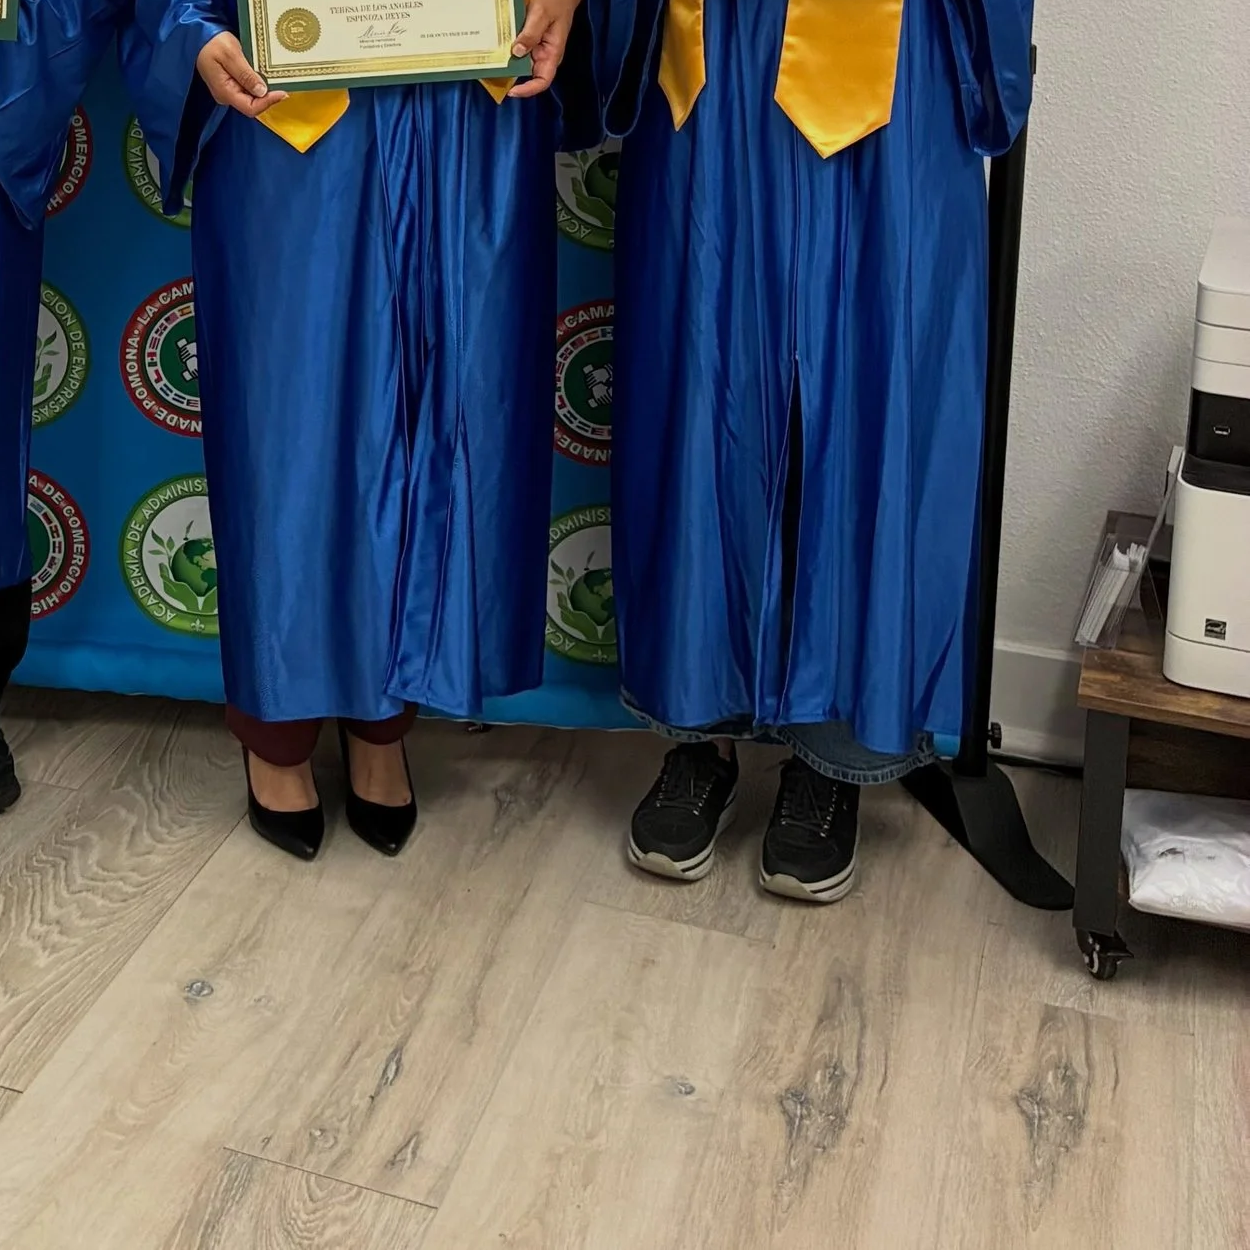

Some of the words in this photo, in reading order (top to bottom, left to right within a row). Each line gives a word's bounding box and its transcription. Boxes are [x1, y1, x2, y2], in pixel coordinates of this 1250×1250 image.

[139, 305, 158, 325] LA
[70, 330, 85, 351] DE
[43, 483, 64, 504] DE
[59, 506, 85, 594] COMERCIO
[126, 519, 144, 542] DE
[125, 550, 177, 623] ACADEMIA
